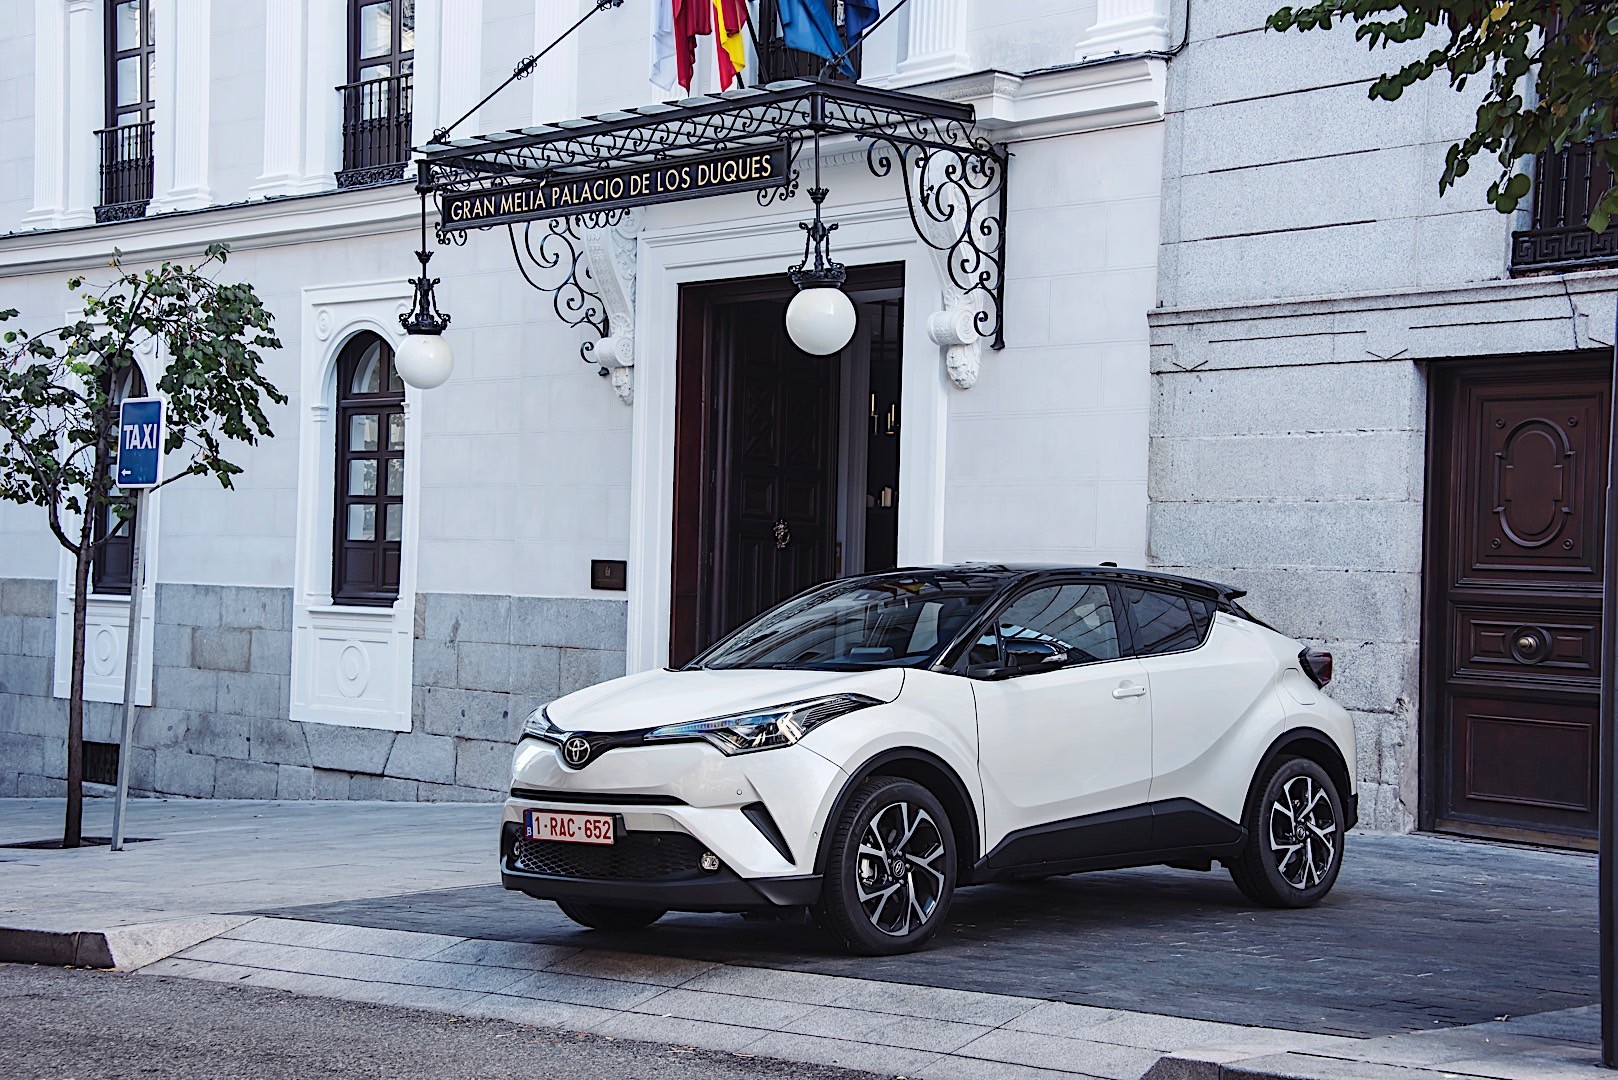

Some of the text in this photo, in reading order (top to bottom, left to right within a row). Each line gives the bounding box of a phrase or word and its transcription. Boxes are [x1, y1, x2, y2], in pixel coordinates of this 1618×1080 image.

[451, 154, 772, 220] GRAN MELIÁ PALACIO DE LOS DUQUES
[123, 423, 158, 450] TAXI
[526, 826, 532, 836] B
[534, 816, 612, 839] 1-RAC-652
